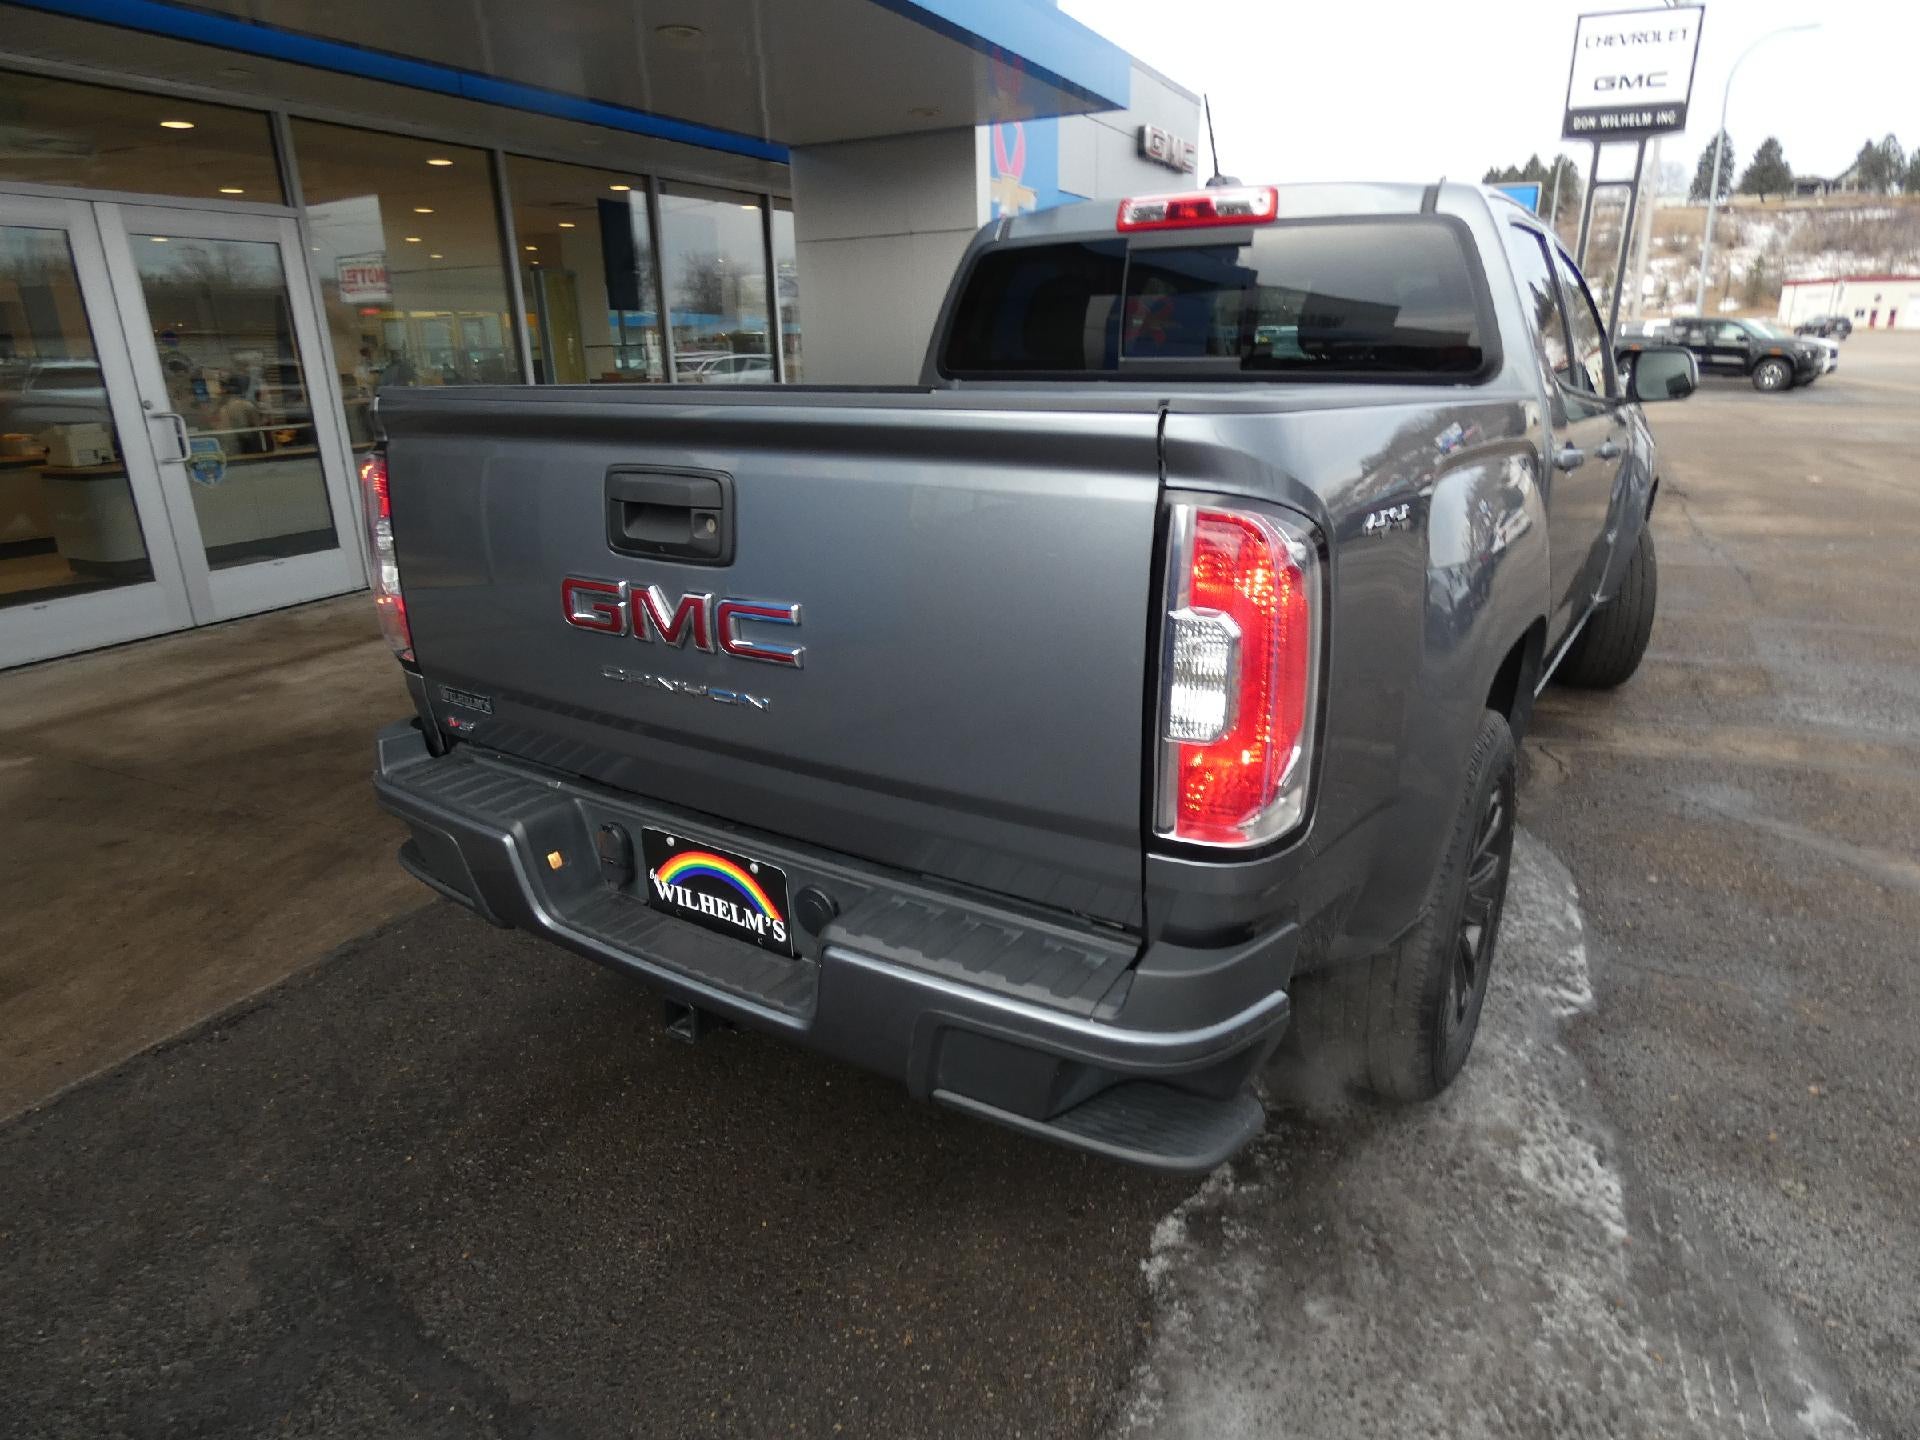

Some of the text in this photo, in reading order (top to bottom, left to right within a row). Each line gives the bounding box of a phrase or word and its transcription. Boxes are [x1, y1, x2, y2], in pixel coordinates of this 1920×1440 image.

[1585, 27, 1689, 49] CHEVROLET
[1593, 71, 1668, 91] GMC
[1573, 115, 1596, 131] DON
[1600, 111, 1653, 129] WILHELM
[1144, 124, 1196, 174] GMC
[561, 573, 805, 669] GMC
[602, 664, 771, 712] CANYON
